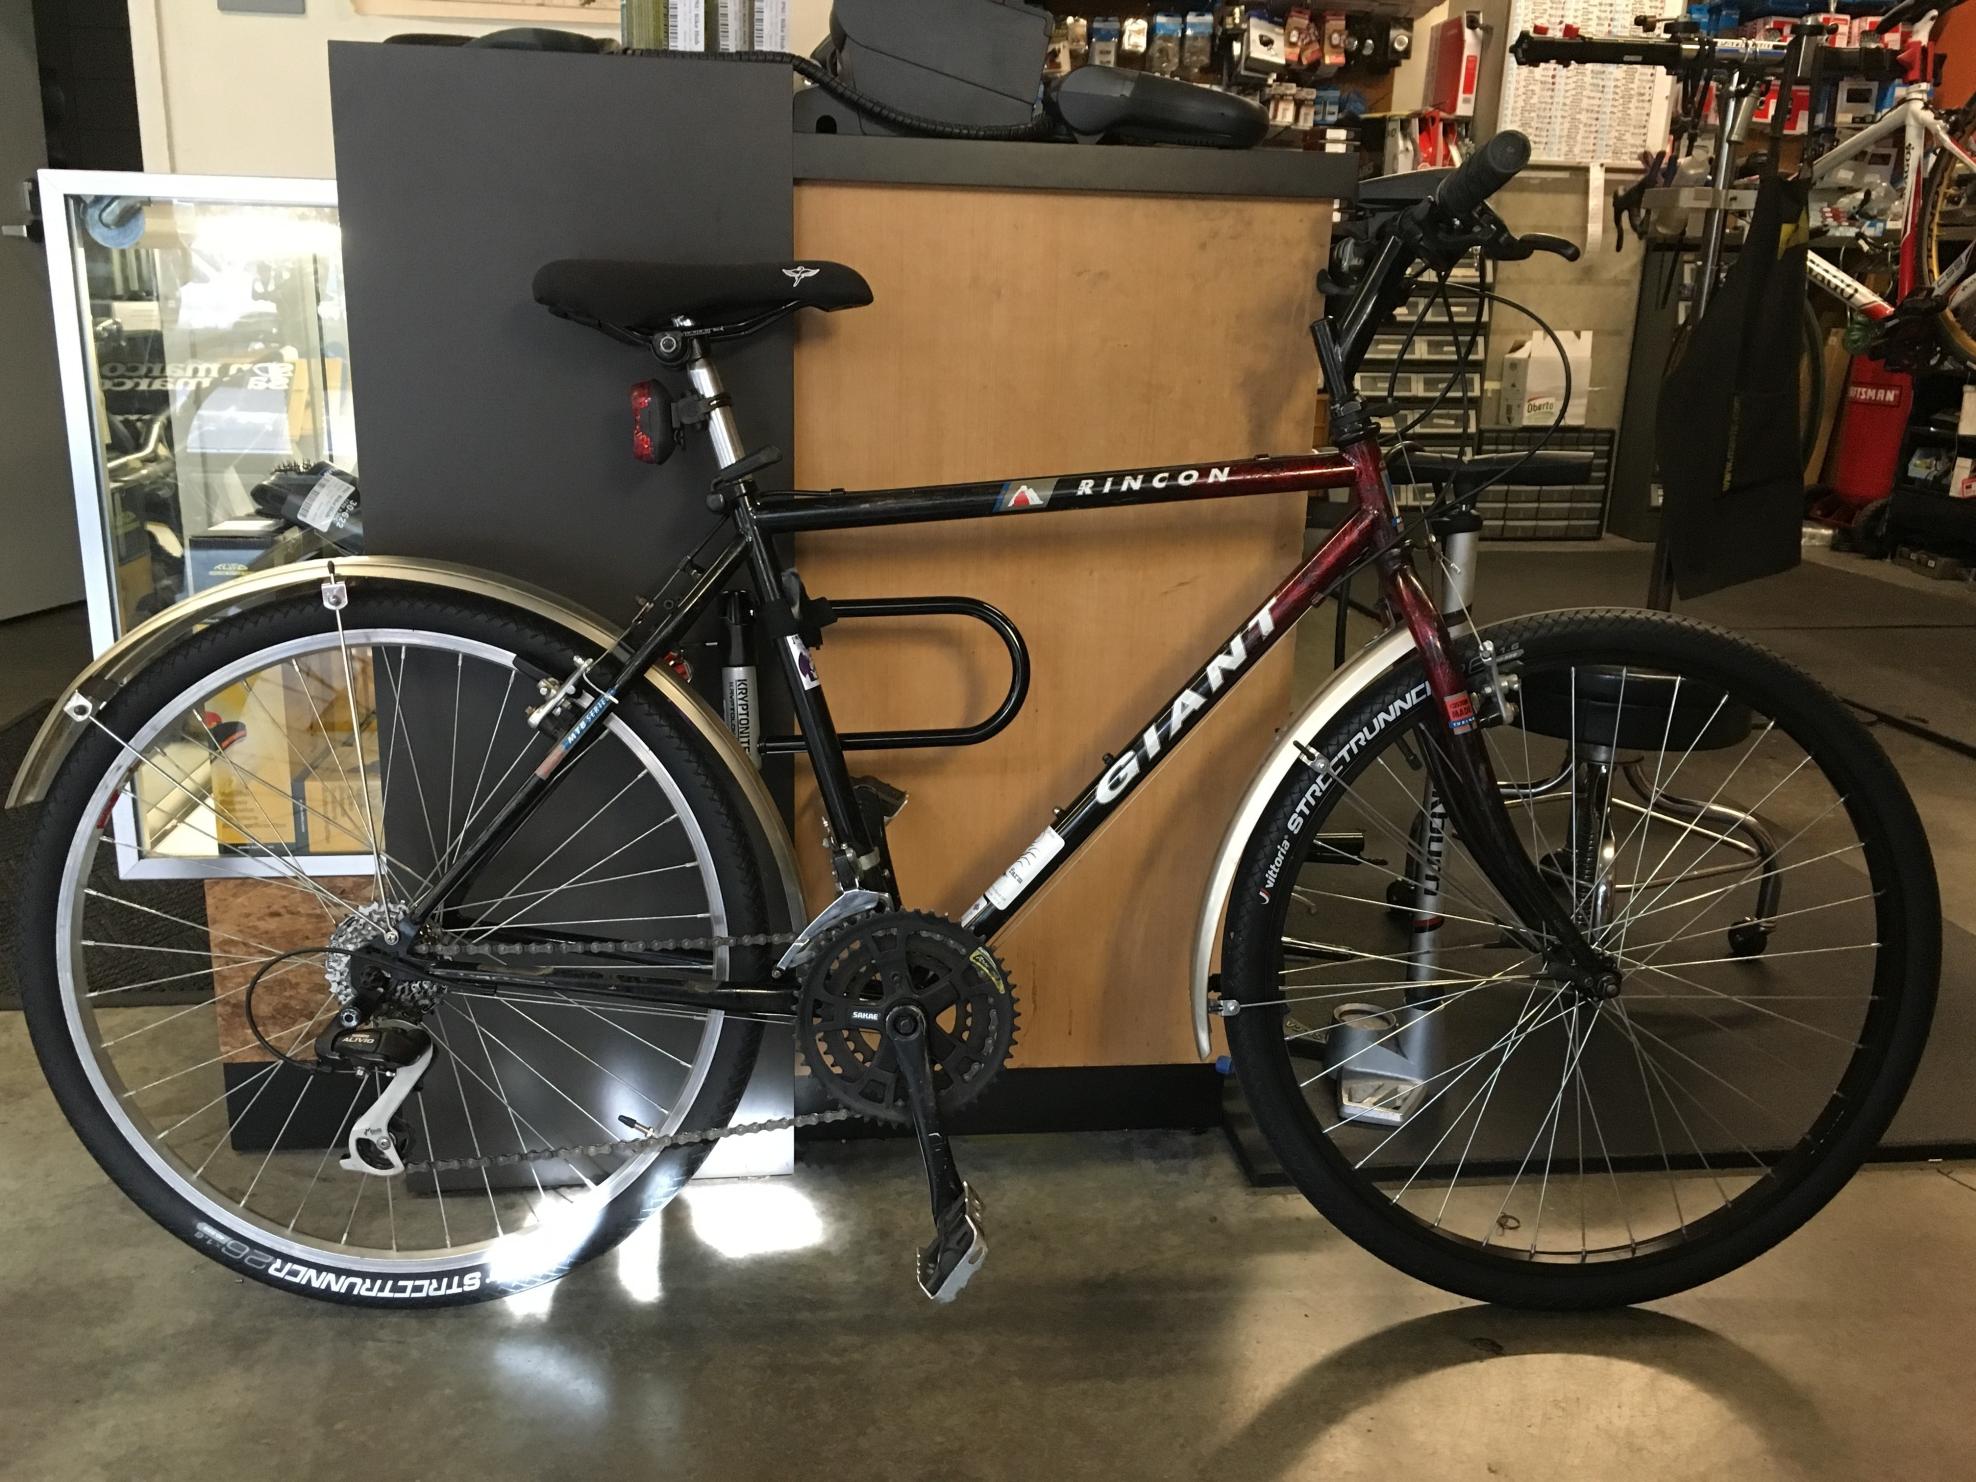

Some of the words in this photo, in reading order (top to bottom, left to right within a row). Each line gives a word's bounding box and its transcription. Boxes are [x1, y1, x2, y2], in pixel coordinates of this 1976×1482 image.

[1526, 401, 1554, 414] Oberto
[1076, 467, 1231, 496] RINCON
[1096, 597, 1277, 804] GIANT
[567, 721, 587, 744] MTB
[1264, 837, 1291, 889] vittoria
[1008, 868, 1024, 884] farm
[852, 1011, 879, 1020] SAKAE
[342, 1036, 375, 1045] ALIVIO
